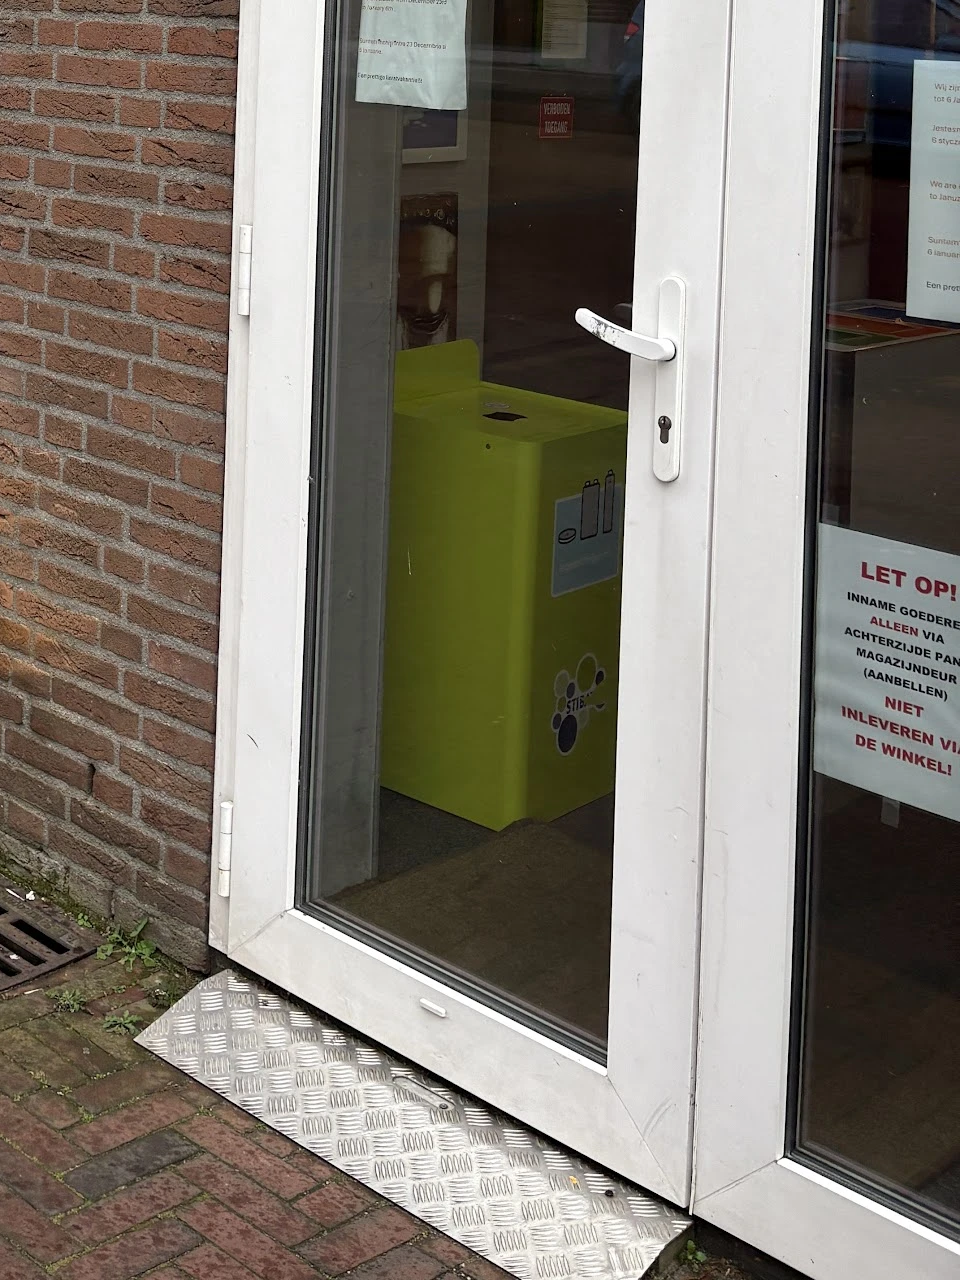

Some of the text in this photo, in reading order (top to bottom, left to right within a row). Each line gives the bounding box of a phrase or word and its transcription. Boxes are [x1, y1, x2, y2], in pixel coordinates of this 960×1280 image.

[543, 102, 571, 115] VERBODEN
[544, 120, 569, 134] TOEGANG
[861, 561, 957, 602] LET OP!
[847, 591, 896, 613] INNAME
[844, 626, 932, 660] ACHTERZIJDE
[870, 616, 945, 645] ALLEEN VIA
[856, 647, 958, 685] MAGAZIJNDEUR
[863, 667, 948, 702] (AANBELLEN)
[884, 695, 925, 718] NIET
[841, 705, 960, 755] INLEVEREN VI
[855, 733, 952, 777] DE WINKEL!
